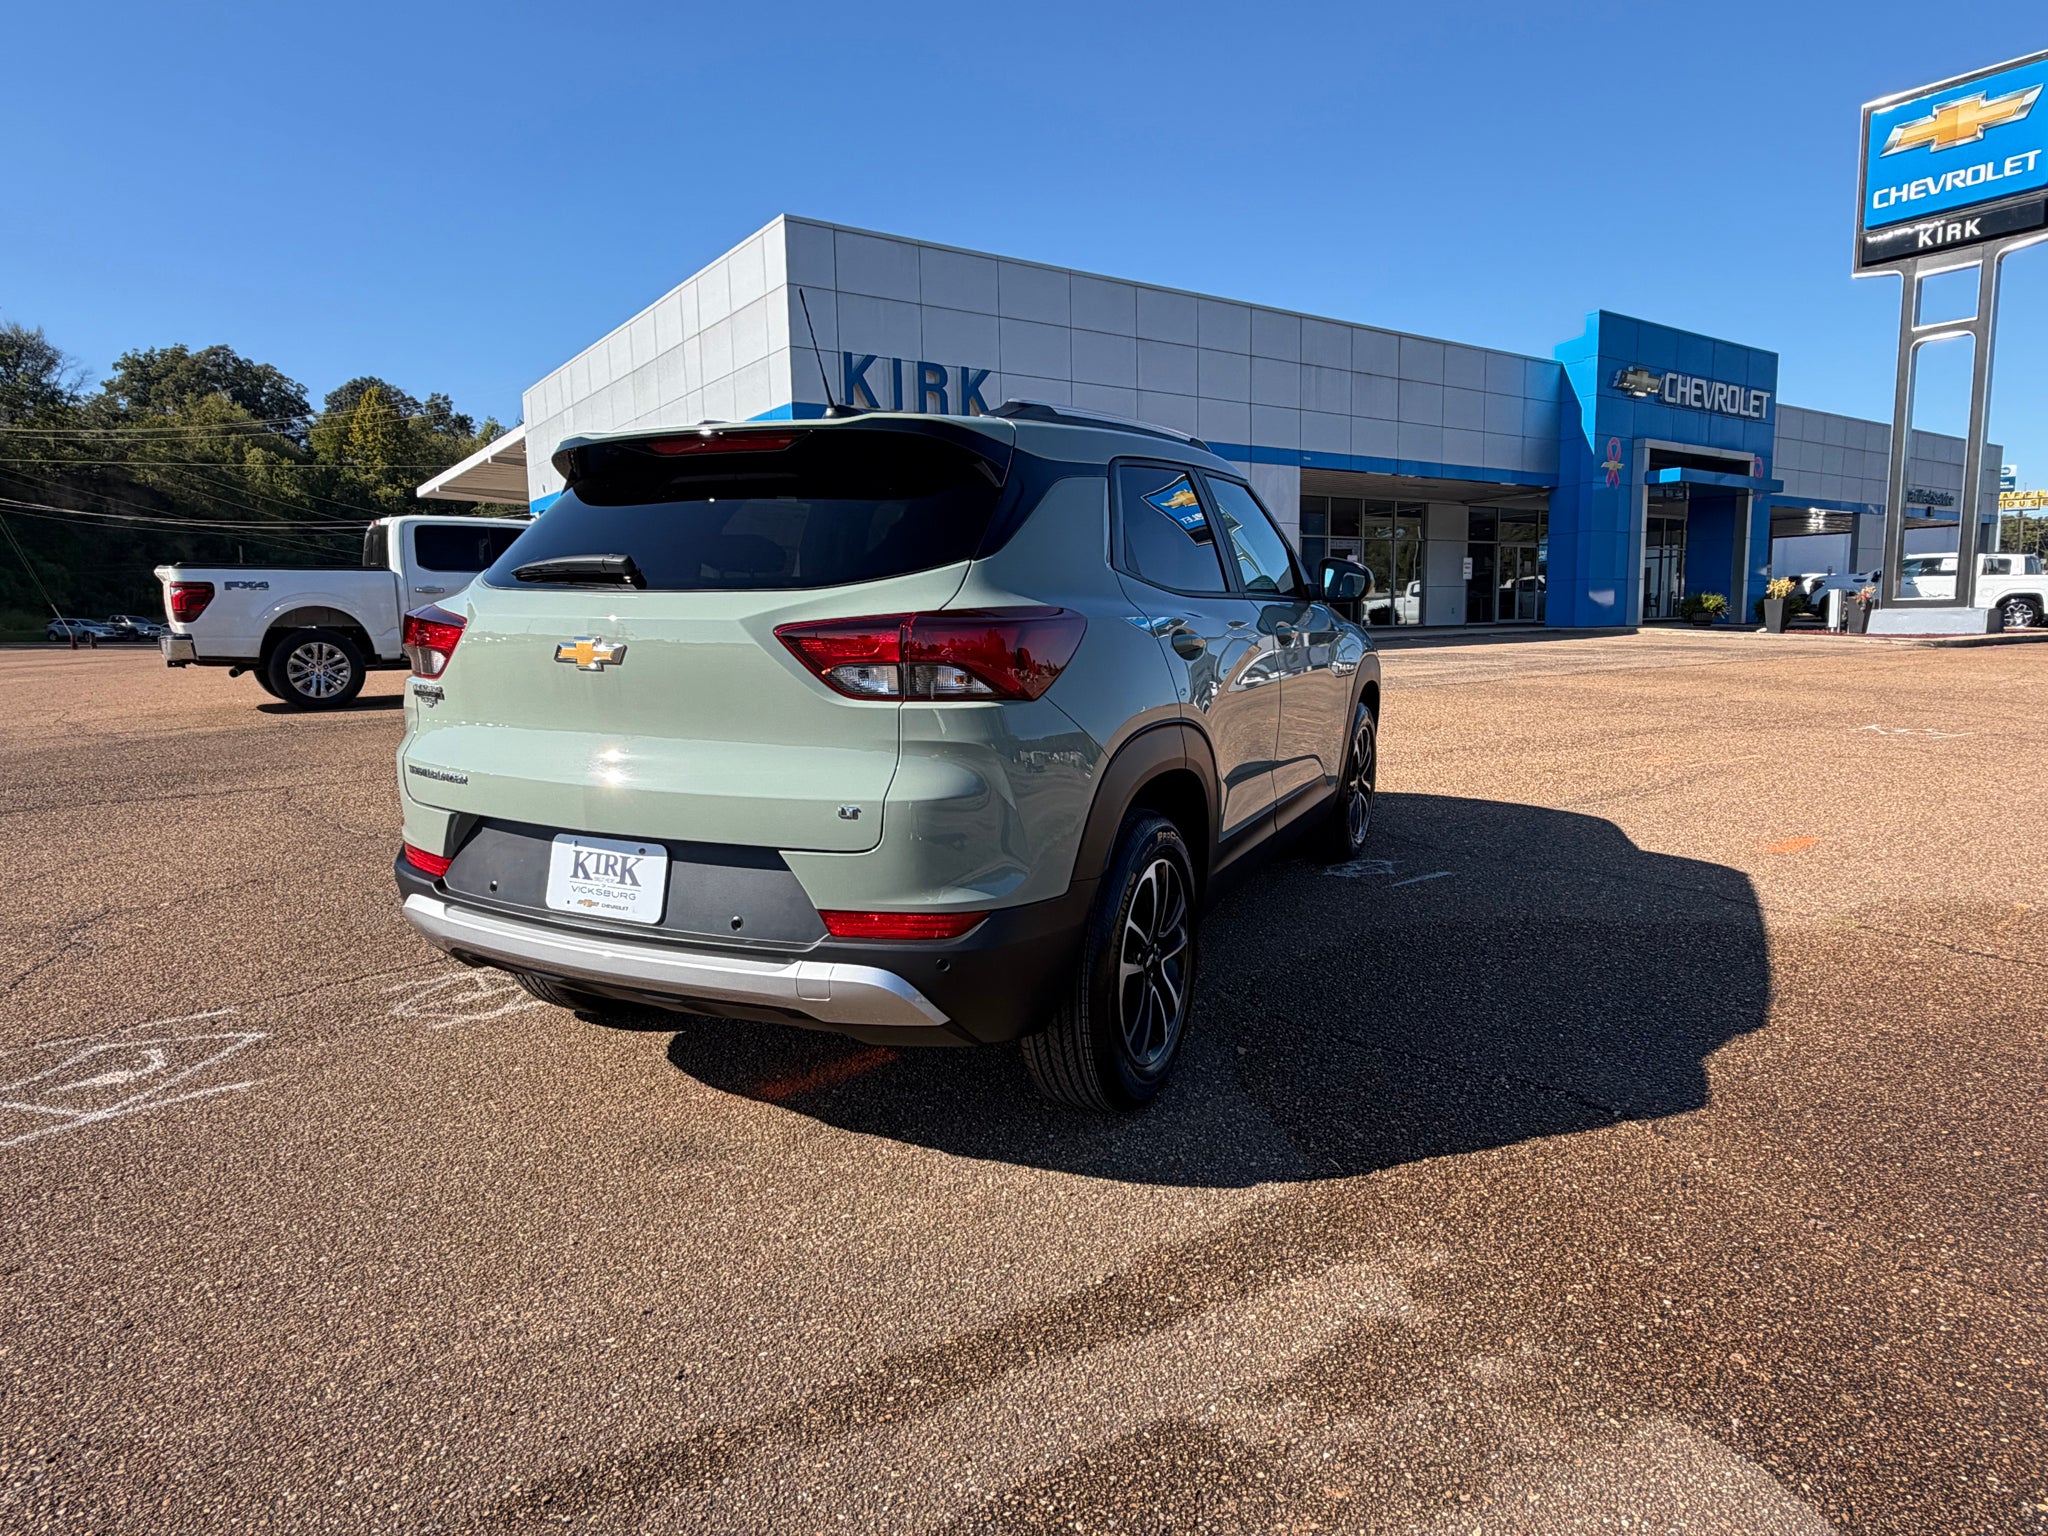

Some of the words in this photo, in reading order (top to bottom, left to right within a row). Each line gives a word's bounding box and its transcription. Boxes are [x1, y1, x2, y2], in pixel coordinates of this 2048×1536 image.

[1872, 149, 2042, 210] CHEVROLET
[1917, 217, 1982, 249] KIRK
[843, 351, 992, 417] KIRK
[1664, 372, 1771, 419] CHEVROLET
[223, 580, 270, 591] FX4
[838, 806, 862, 820] LT
[570, 850, 643, 887] KIRK
[572, 886, 636, 900] VICKSBURG
